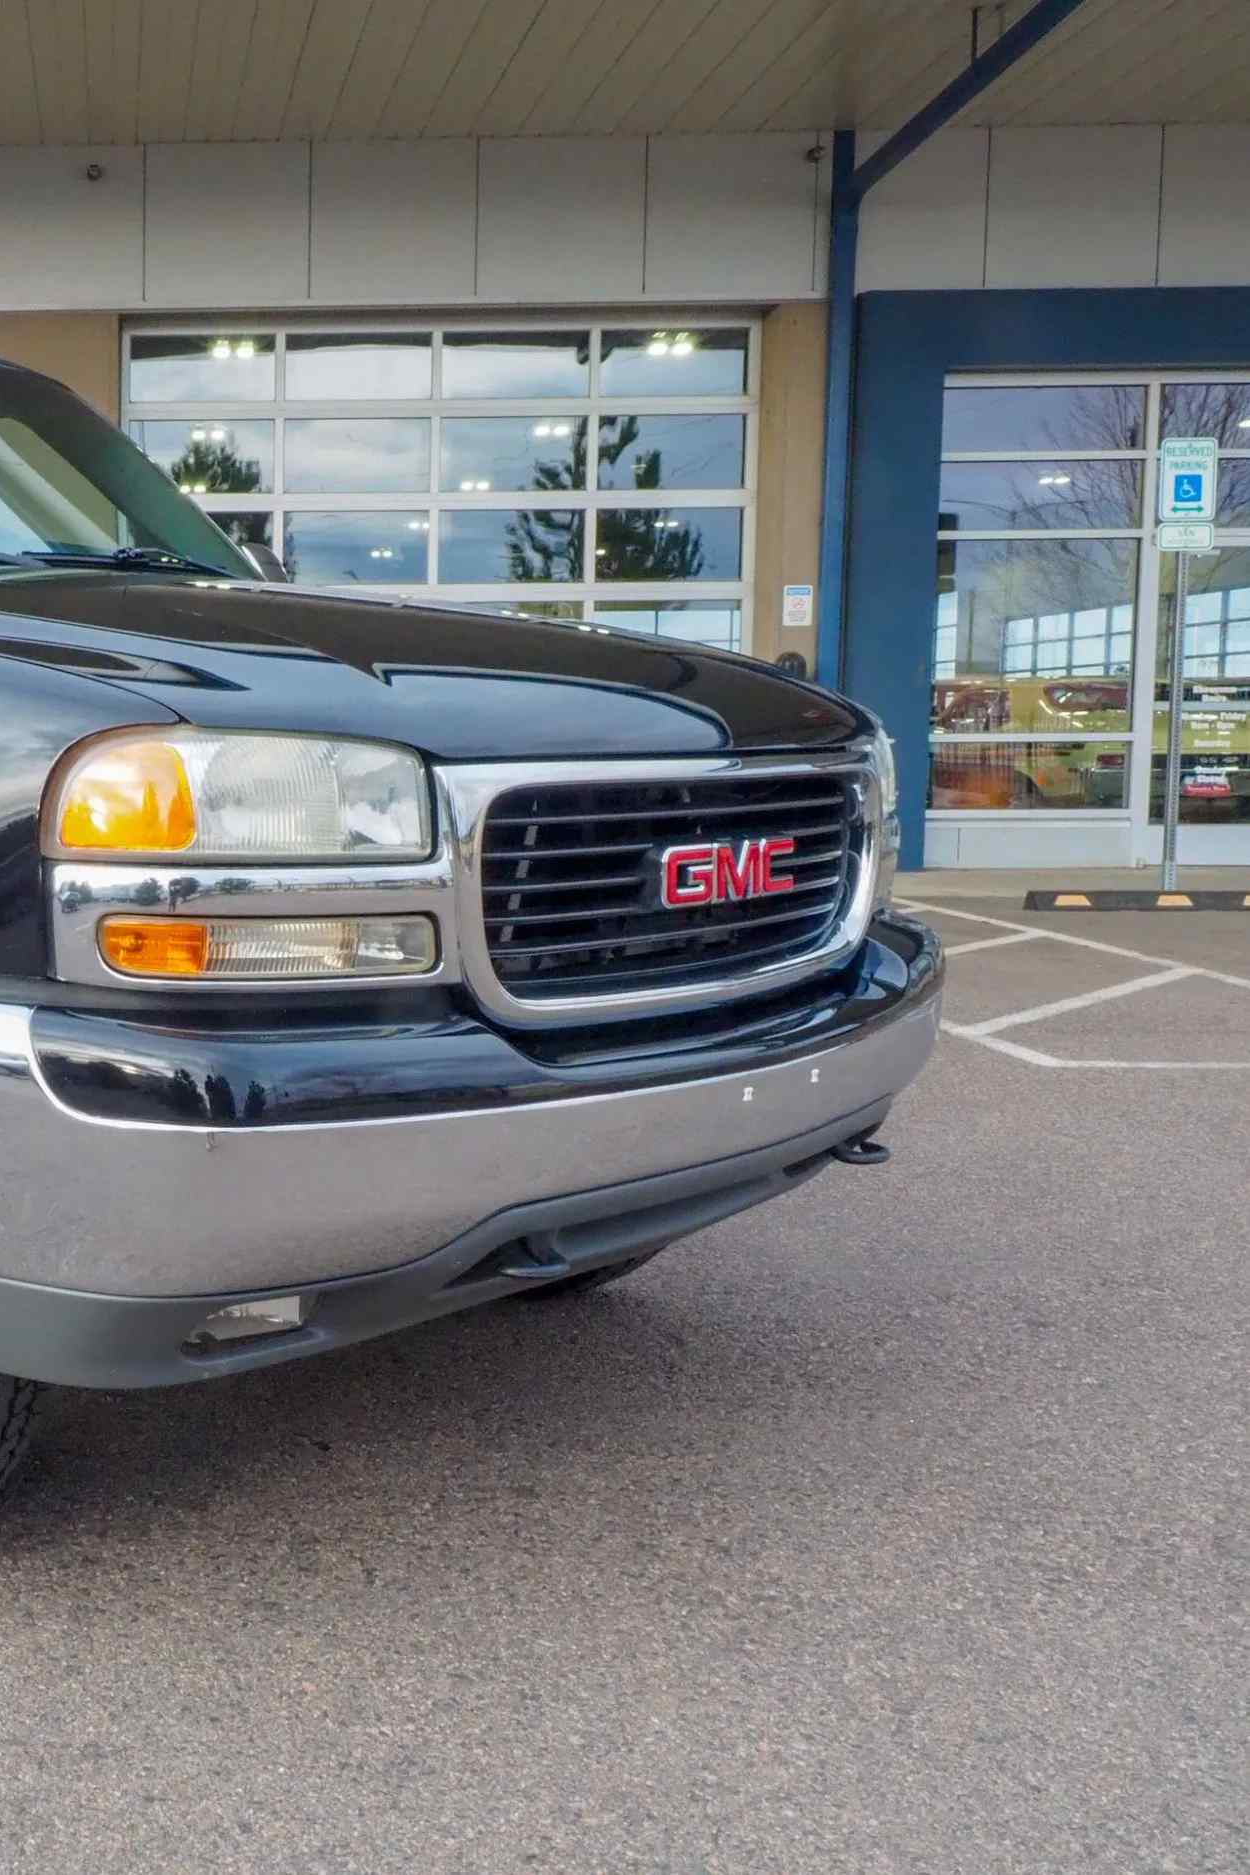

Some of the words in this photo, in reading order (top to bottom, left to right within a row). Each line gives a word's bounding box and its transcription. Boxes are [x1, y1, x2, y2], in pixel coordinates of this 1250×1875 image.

[1166, 447, 1213, 457] RESERVED
[1169, 461, 1209, 470] PARKING
[661, 838, 797, 909] GMC
